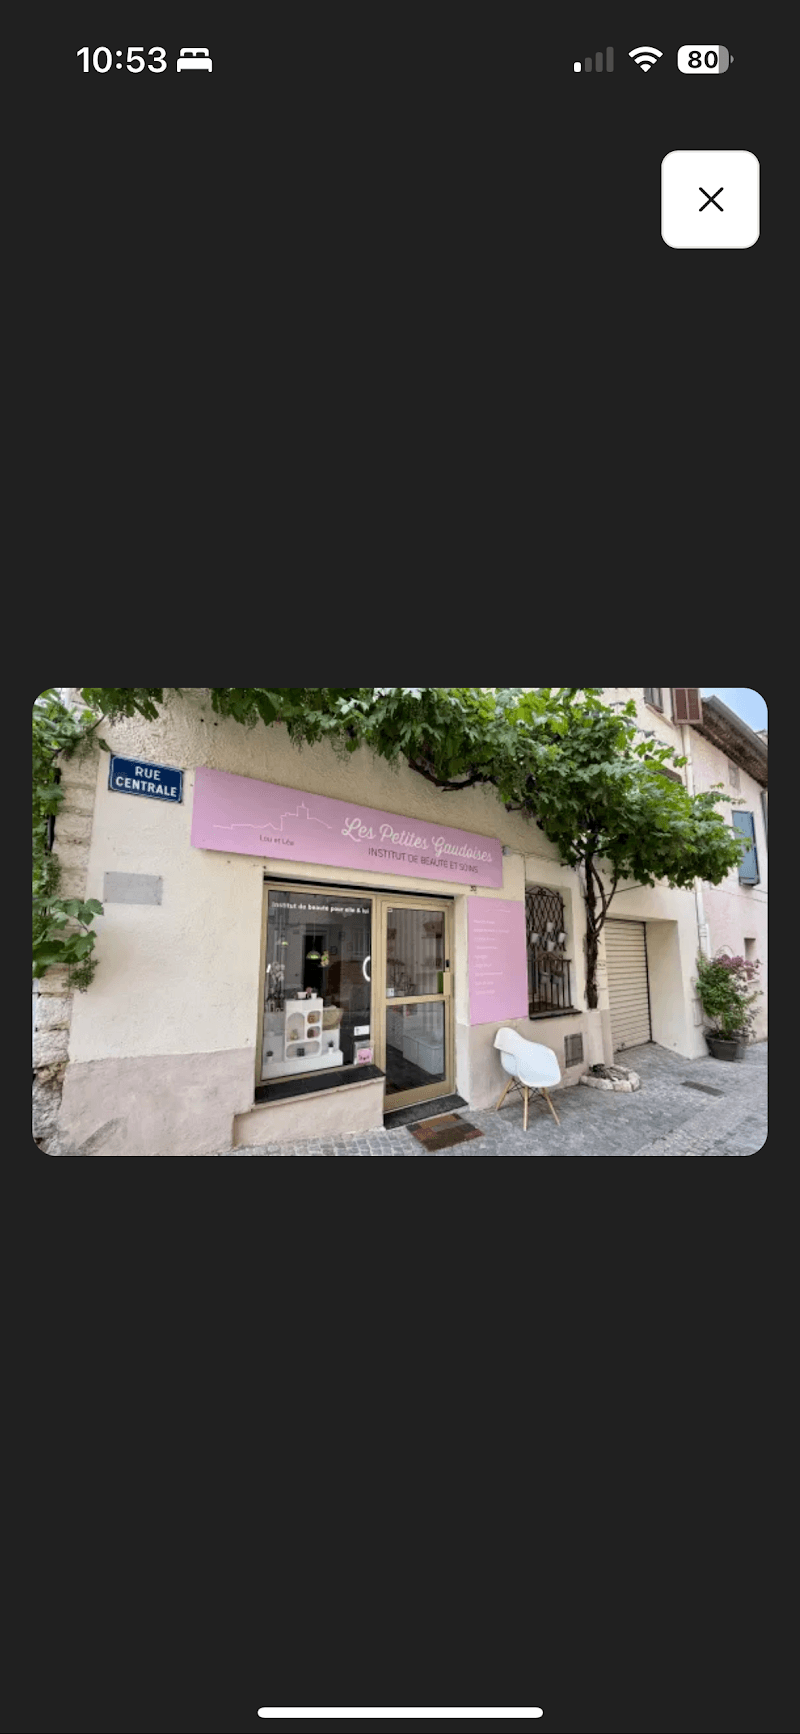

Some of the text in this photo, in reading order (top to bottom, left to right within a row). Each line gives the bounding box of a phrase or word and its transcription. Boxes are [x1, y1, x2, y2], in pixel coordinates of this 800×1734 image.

[134, 766, 161, 781] RUE
[115, 776, 177, 797] CENTRALE
[341, 817, 493, 862] Les Petites Gaudoises
[368, 847, 406, 861] INSTITUT
[407, 853, 419, 864] DE
[449, 860, 458, 870] ET
[458, 862, 479, 873] SOINS
